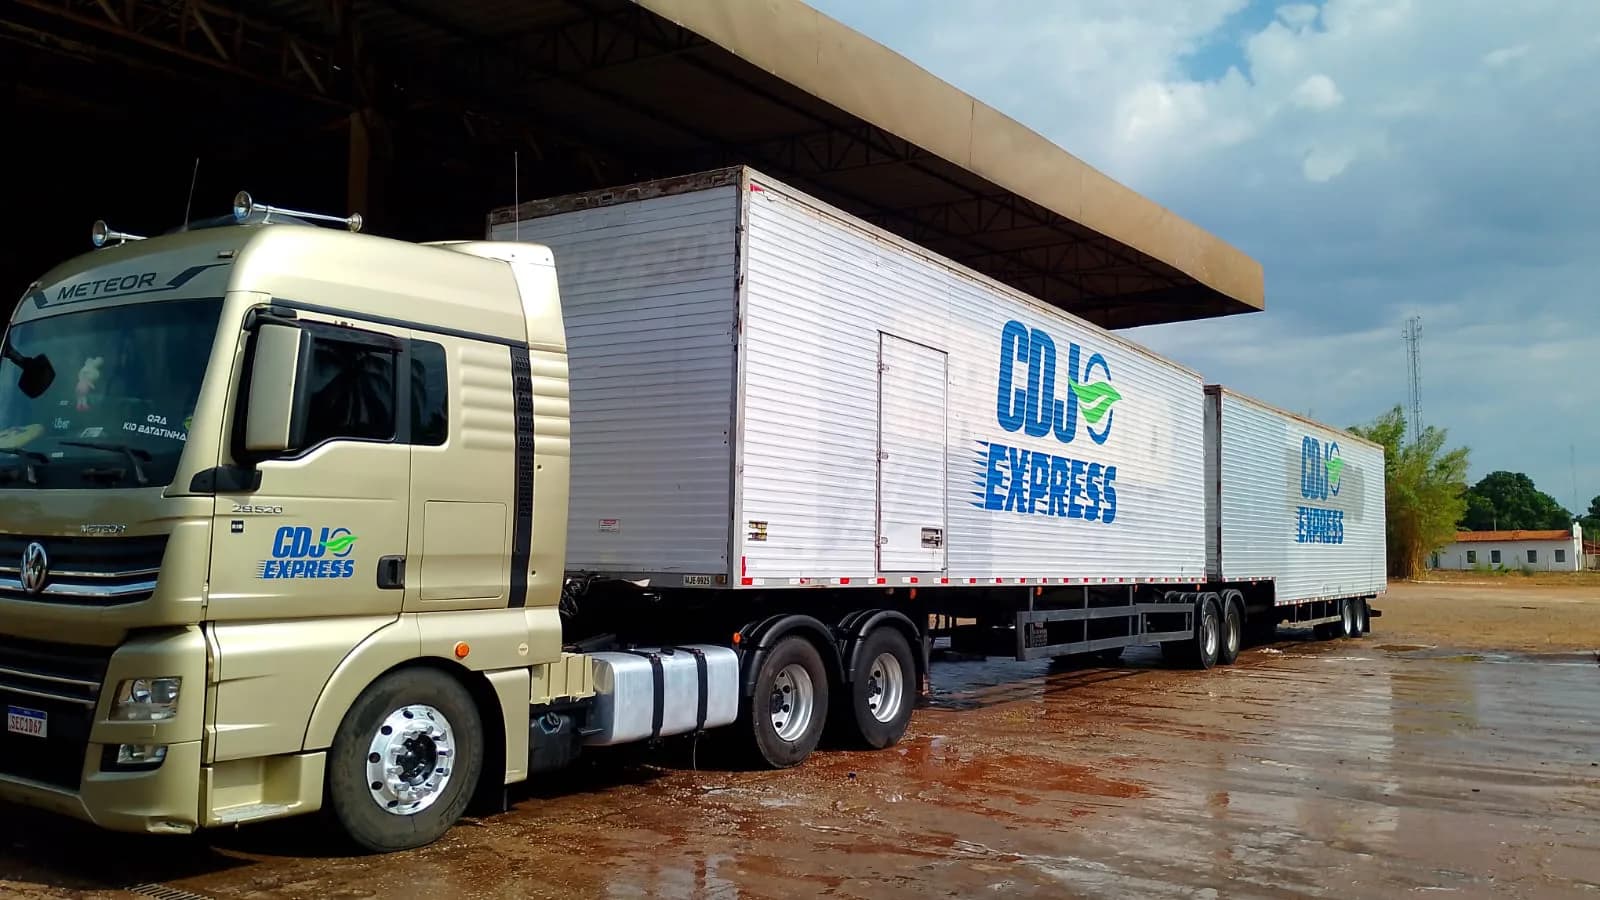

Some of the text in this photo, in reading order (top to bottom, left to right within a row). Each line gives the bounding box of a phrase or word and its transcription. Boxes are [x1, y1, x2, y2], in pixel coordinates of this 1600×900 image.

[57, 272, 157, 300] METEOR
[123, 422, 187, 441] KID BATATINHA
[147, 414, 167, 425] QRA
[984, 443, 1117, 524] EXPRESS
[1297, 506, 1344, 545] EXPRESS
[262, 559, 355, 579] EXPRESS
